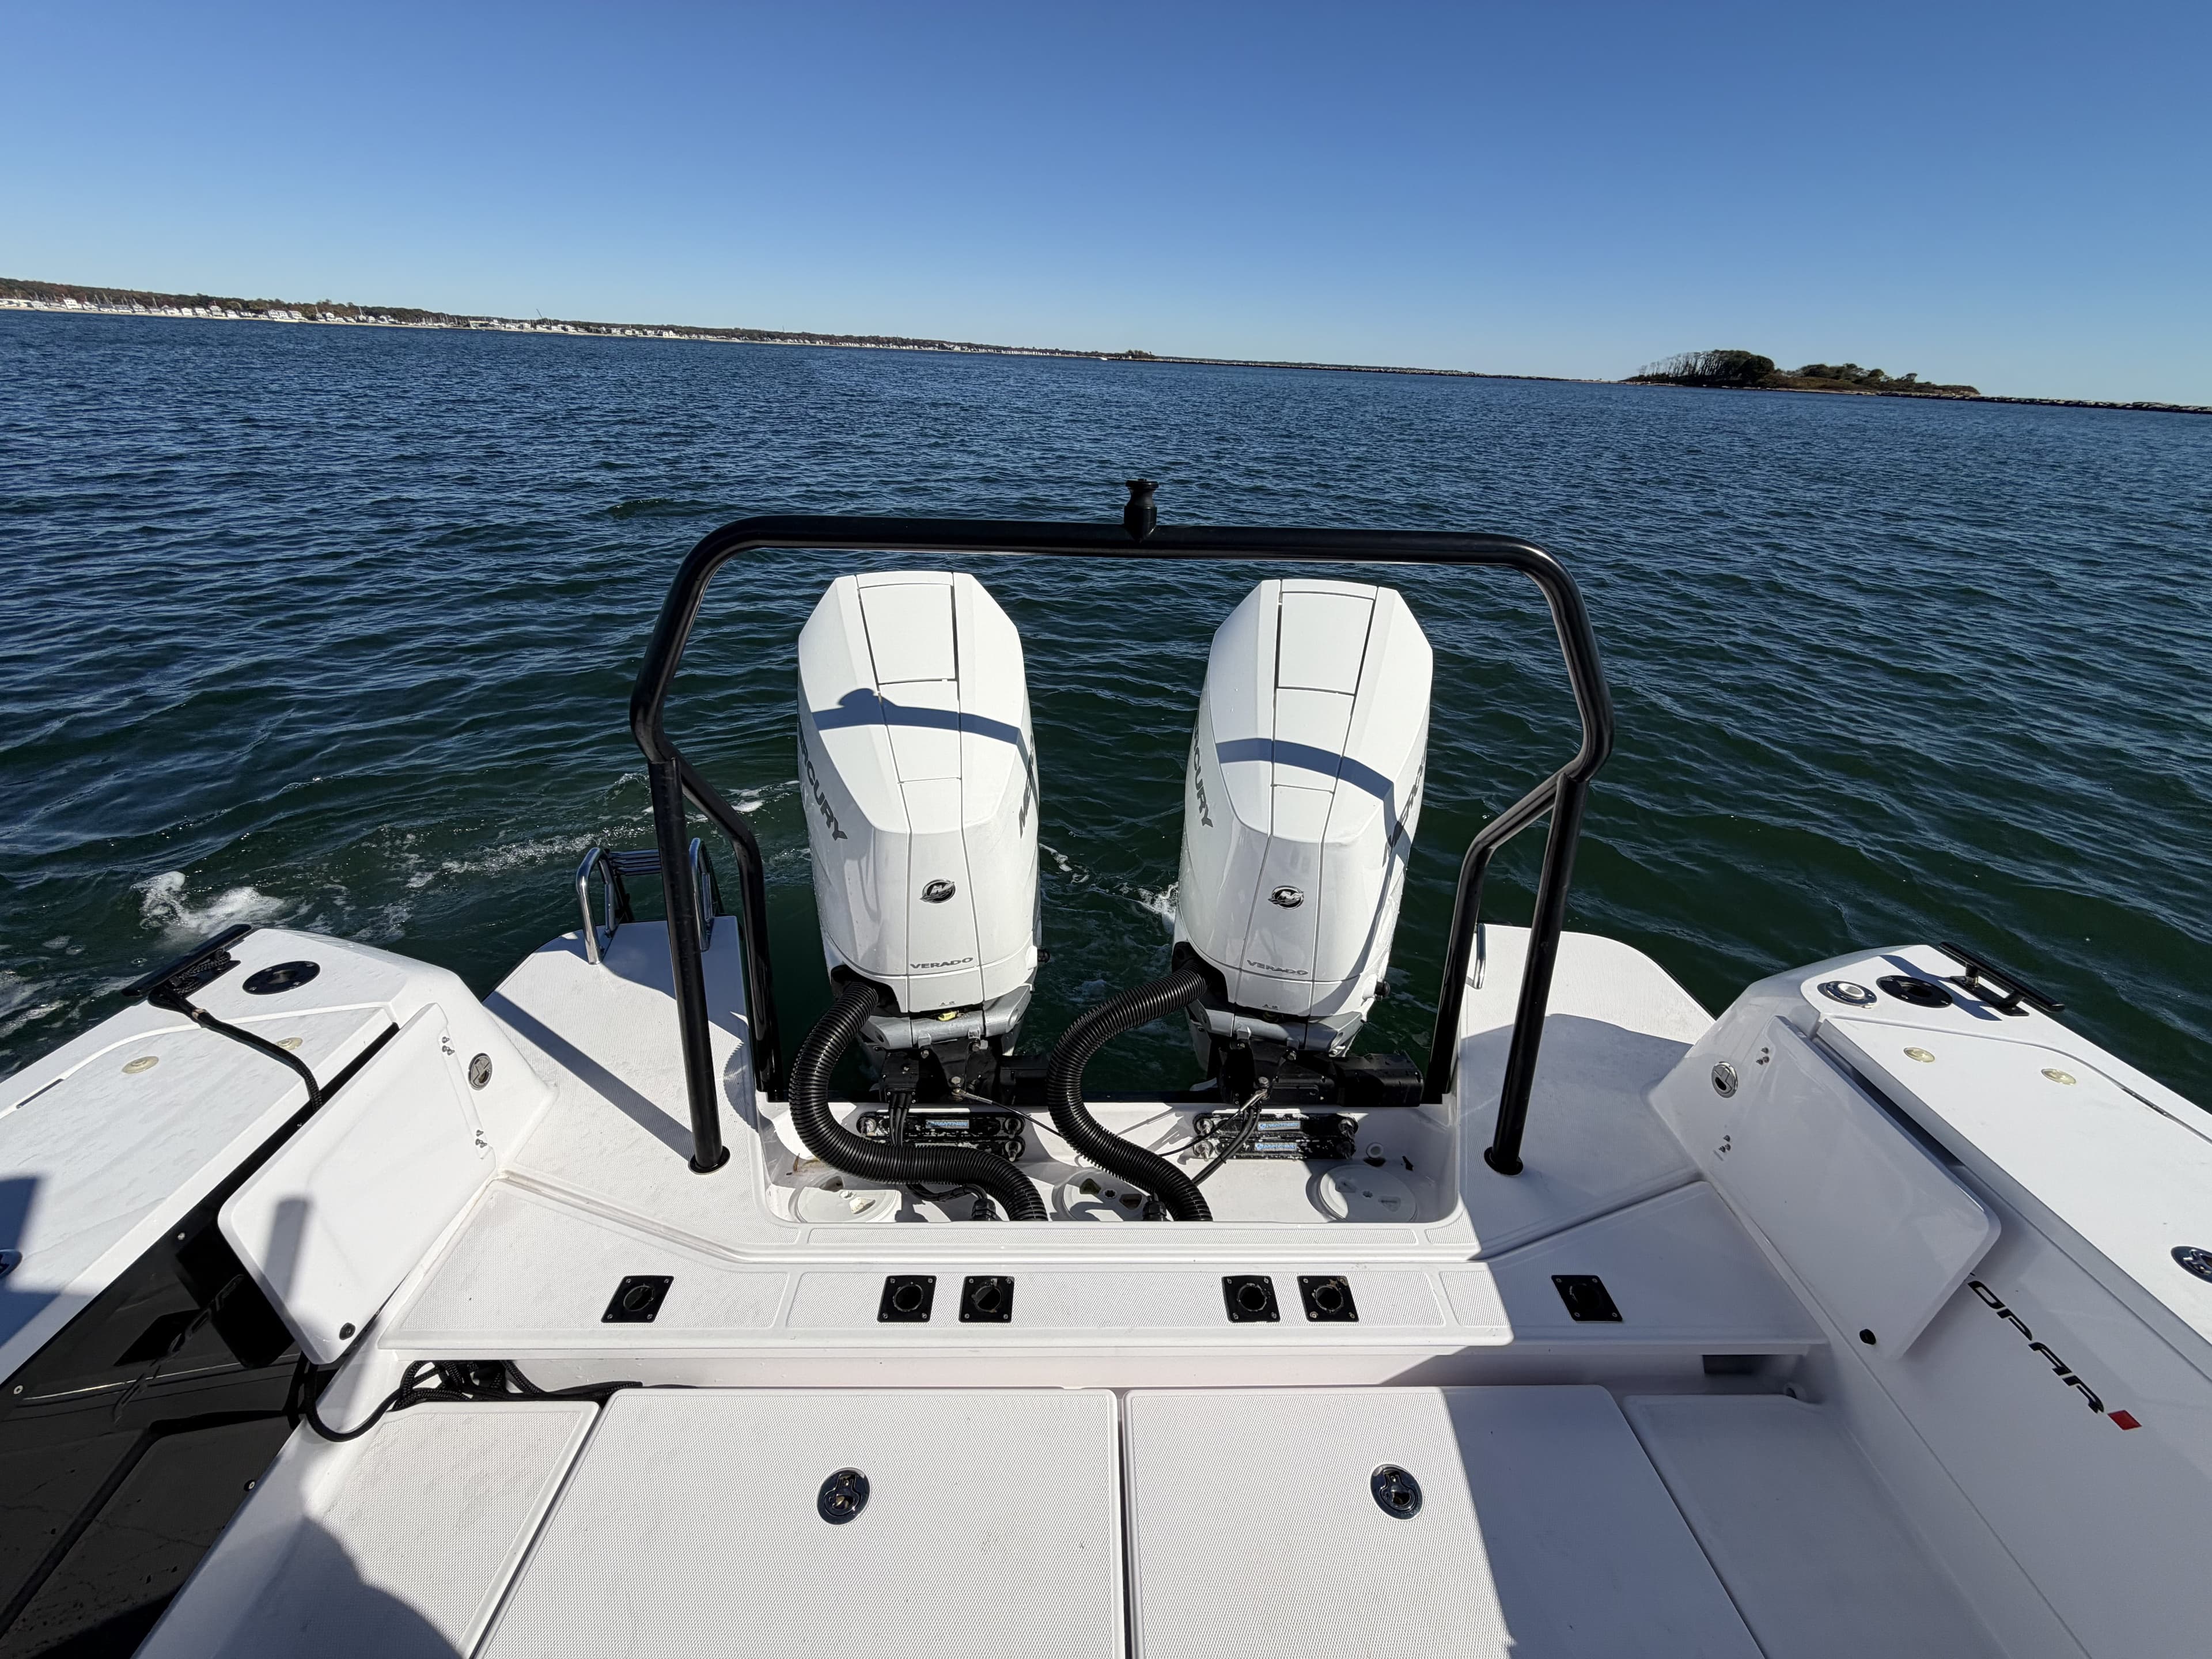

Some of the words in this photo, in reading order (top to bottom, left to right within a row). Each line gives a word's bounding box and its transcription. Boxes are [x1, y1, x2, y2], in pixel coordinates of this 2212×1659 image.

[910, 957, 974, 969] VERADO
[1247, 959, 1308, 975] VERADO
[1967, 1272, 2105, 1414] OPAR
